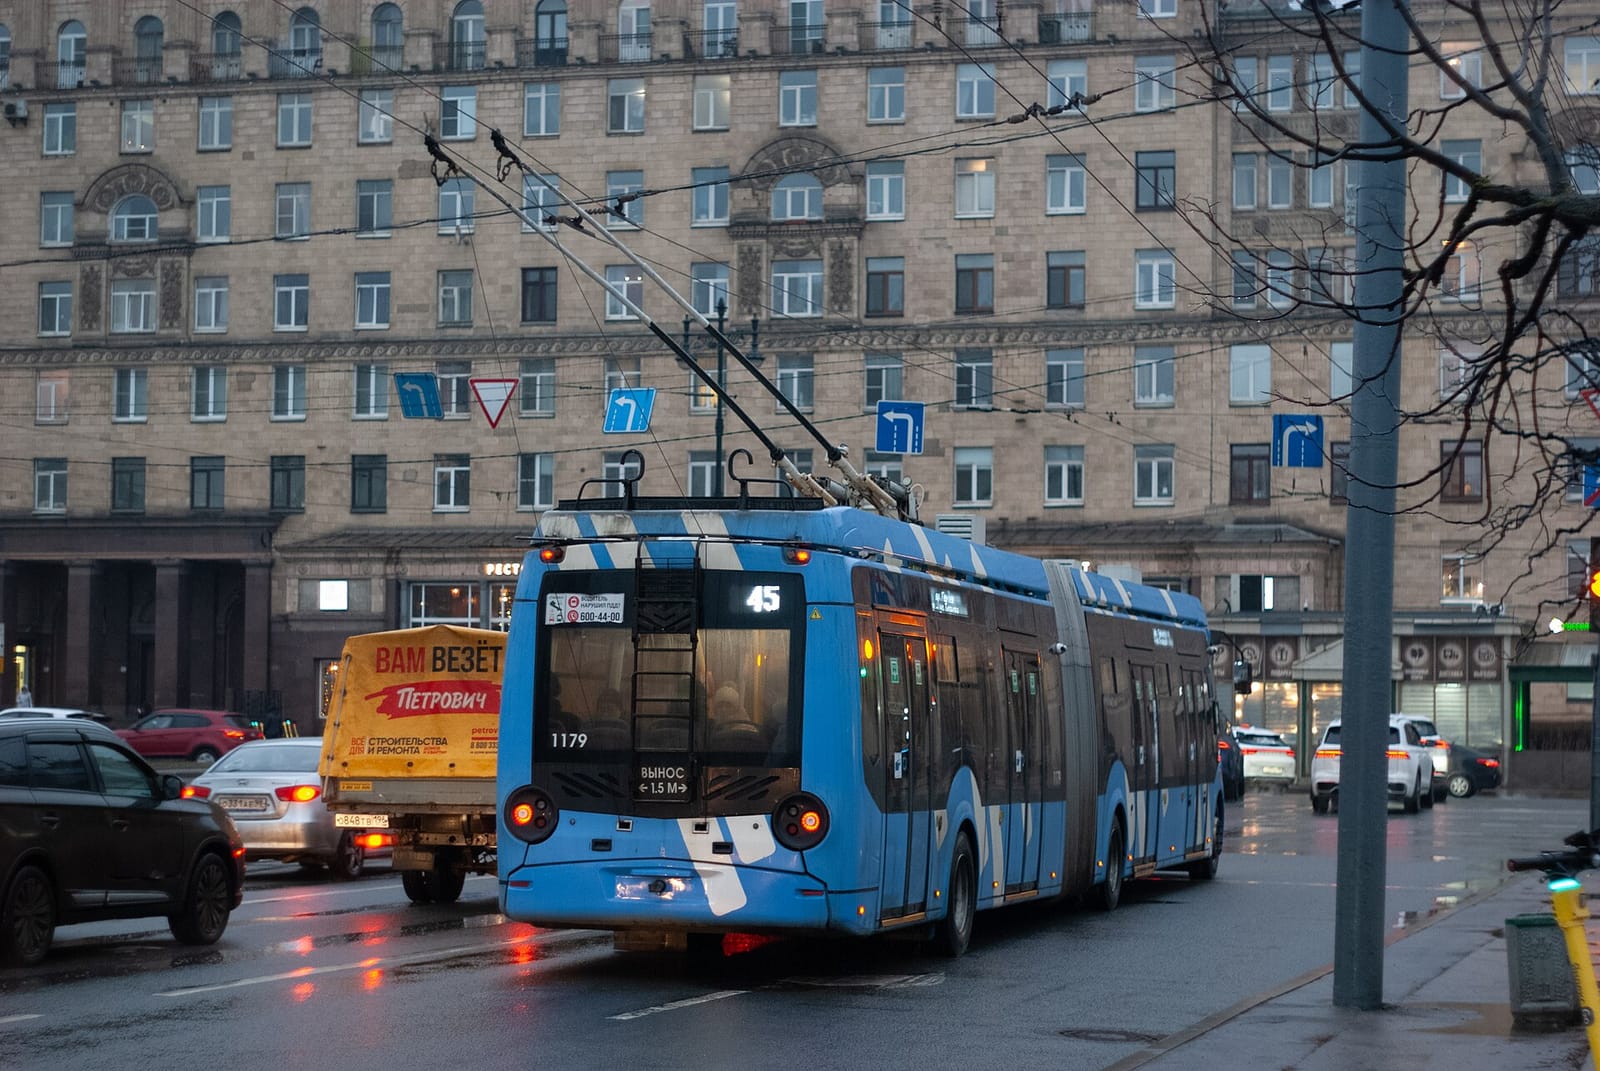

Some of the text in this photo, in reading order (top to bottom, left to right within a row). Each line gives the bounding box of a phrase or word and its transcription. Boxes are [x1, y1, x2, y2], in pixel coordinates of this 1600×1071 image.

[486, 563, 523, 576] РЕСТ
[746, 585, 780, 612] 45
[580, 612, 620, 621] 600-44-00
[376, 640, 503, 673] ВАМ ВЕЗЁТ
[368, 737, 448, 746] СТРОИТЕЛЬСТВА
[552, 733, 588, 748] 1179
[367, 747, 375, 755] И
[376, 746, 420, 755] РЕМОНТА
[641, 767, 685, 779] ВЫНОС
[651, 782, 665, 794] 1.5
